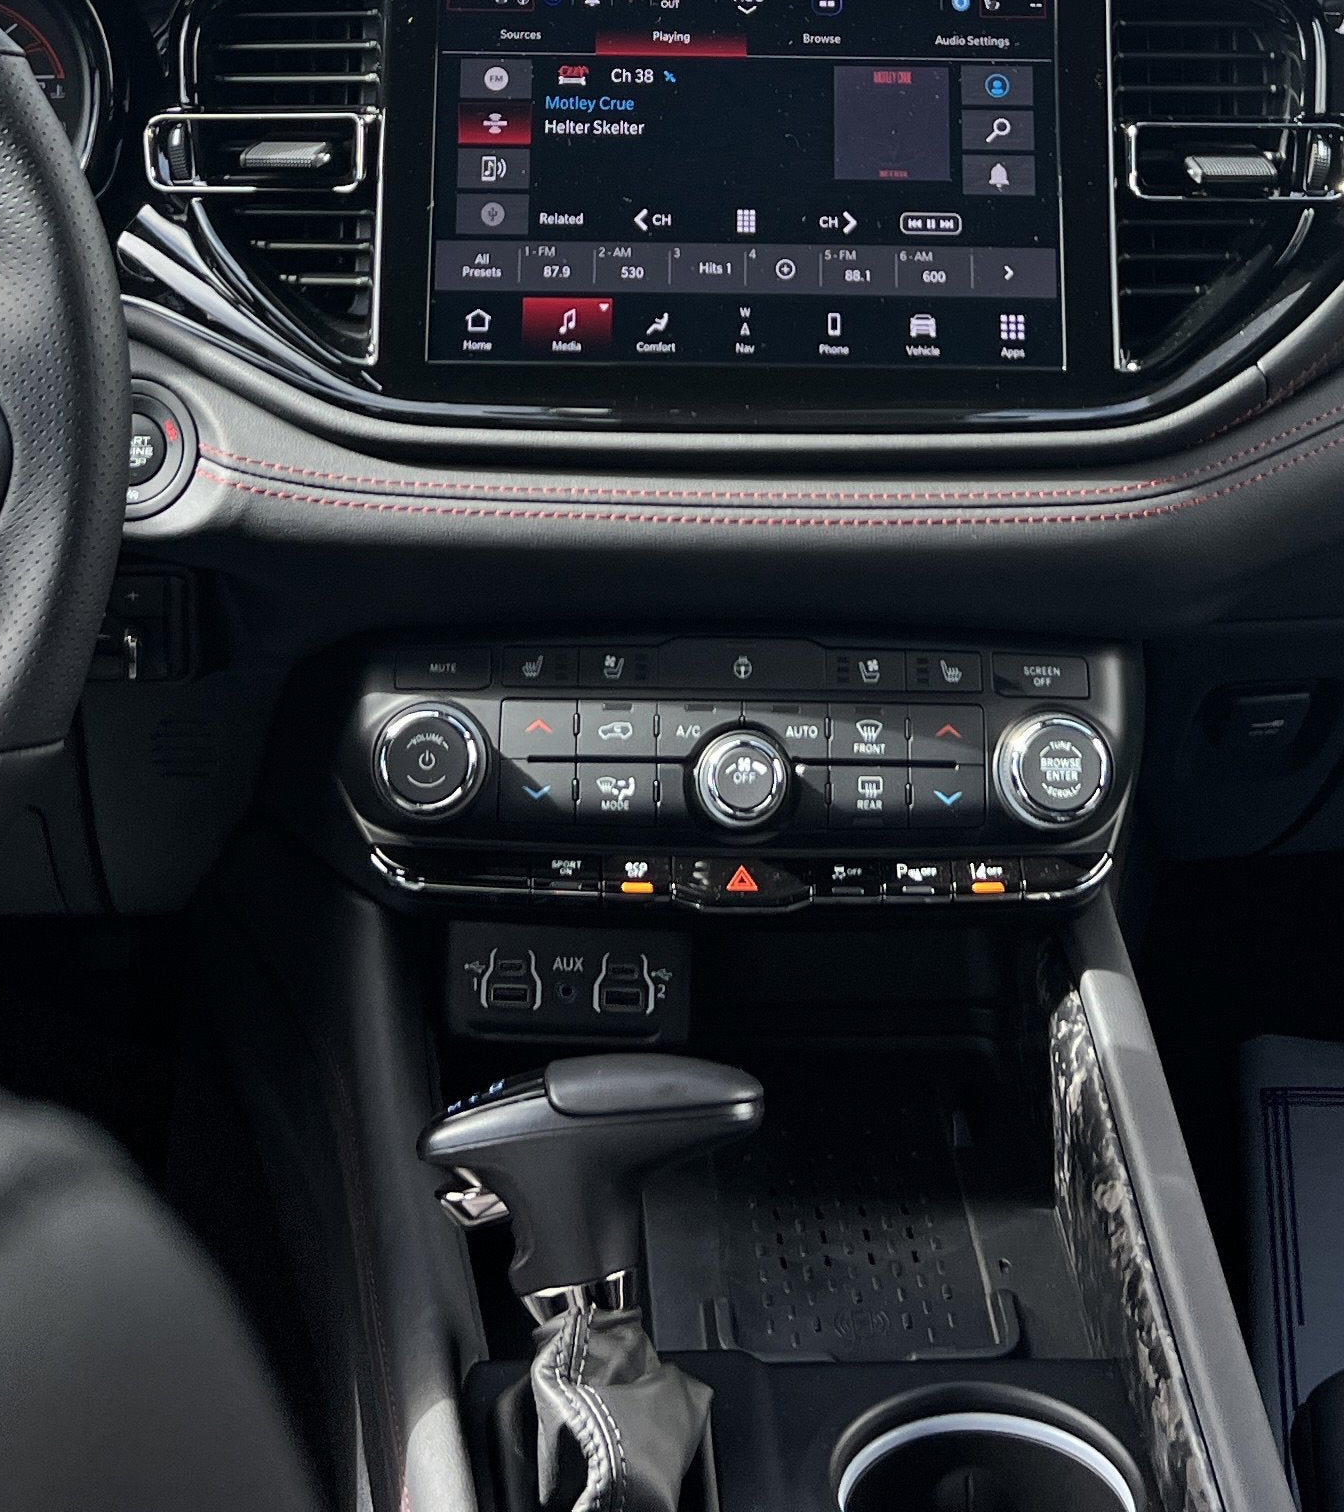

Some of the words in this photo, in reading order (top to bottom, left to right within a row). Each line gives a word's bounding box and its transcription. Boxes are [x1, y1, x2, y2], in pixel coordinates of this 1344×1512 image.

[660, 0, 680, 9] OUT
[500, 29, 542, 40] Sources
[652, 31, 690, 44] Playing
[803, 34, 841, 44] Browse
[935, 35, 965, 46] Audio
[967, 36, 1010, 48] Settings
[611, 68, 632, 83] Ch
[635, 69, 654, 83] 38
[545, 96, 595, 112] Motley
[599, 97, 634, 110] Crue
[545, 120, 591, 134] Helter
[593, 120, 644, 135] Skelter
[539, 213, 583, 225] Related
[652, 215, 671, 226] CH
[819, 216, 838, 228] CH
[474, 253, 489, 264] All
[462, 266, 502, 278] Presets
[543, 266, 571, 278] 87.9
[621, 267, 644, 279] 530
[699, 262, 723, 274] Hits
[845, 270, 871, 282] 88.1
[923, 271, 946, 283] 600
[463, 340, 492, 350] Home
[552, 341, 581, 352] Media
[636, 341, 676, 352] Comfort
[735, 343, 755, 354] Nav
[819, 344, 849, 355] Phone
[906, 345, 940, 357] Vehicle
[1001, 347, 1025, 359] Apps
[429, 663, 457, 673] MUTE
[1023, 666, 1061, 677] SCREEN
[1034, 677, 1051, 687] OFF
[676, 724, 701, 737] A/C
[785, 726, 818, 739] AUTO
[412, 733, 444, 746] VOLUME
[853, 743, 886, 755] FRONT
[1040, 757, 1082, 769] BROWSE
[733, 771, 755, 784] OFF
[1046, 770, 1078, 782] ENTER
[1046, 787, 1078, 799] SCROLL
[601, 800, 630, 811] MODE
[857, 799, 883, 810] REAR
[553, 957, 584, 972] AUX
[657, 985, 666, 999] 2
